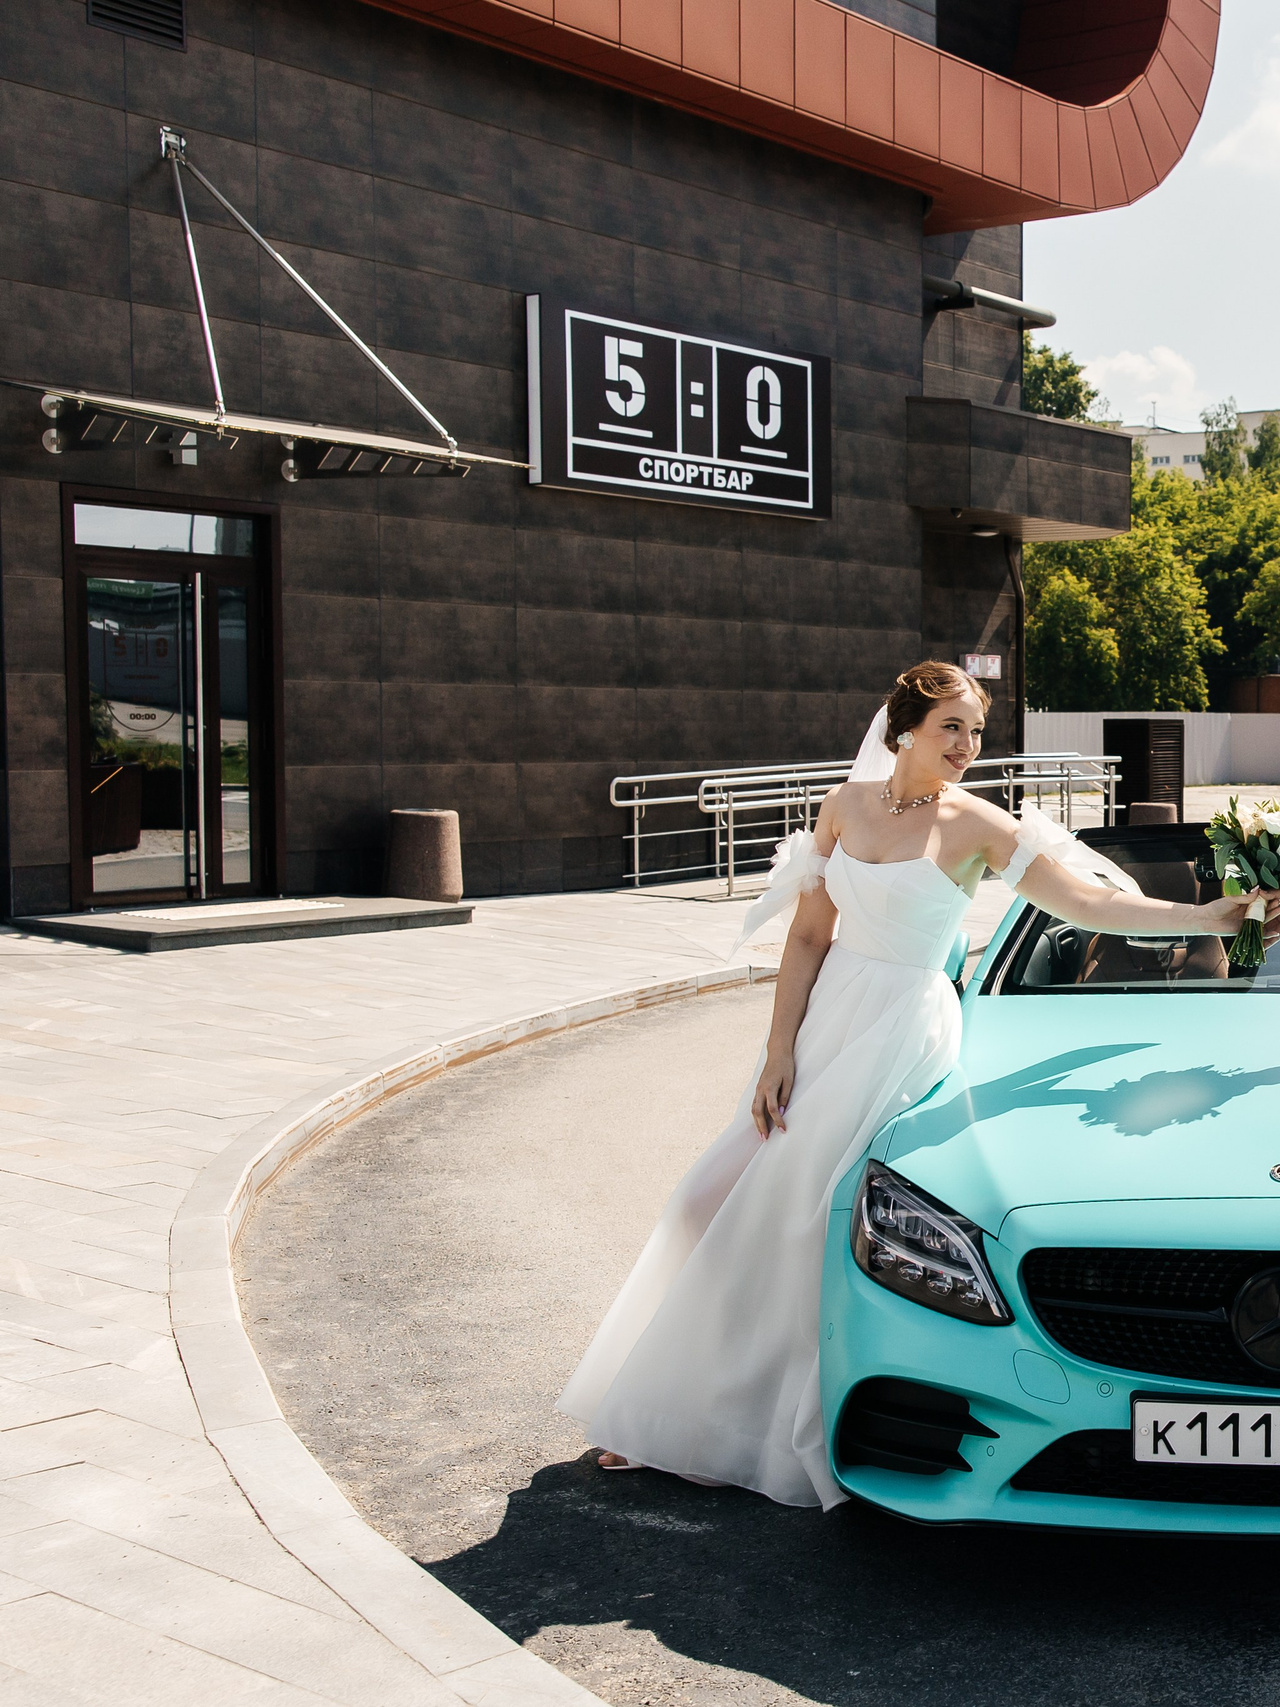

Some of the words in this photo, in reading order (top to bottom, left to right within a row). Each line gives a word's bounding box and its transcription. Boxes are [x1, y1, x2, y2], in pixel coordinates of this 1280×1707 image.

[604, 335, 646, 418] 5
[746, 365, 782, 440] 0
[638, 457, 754, 491] СПОРТБАР
